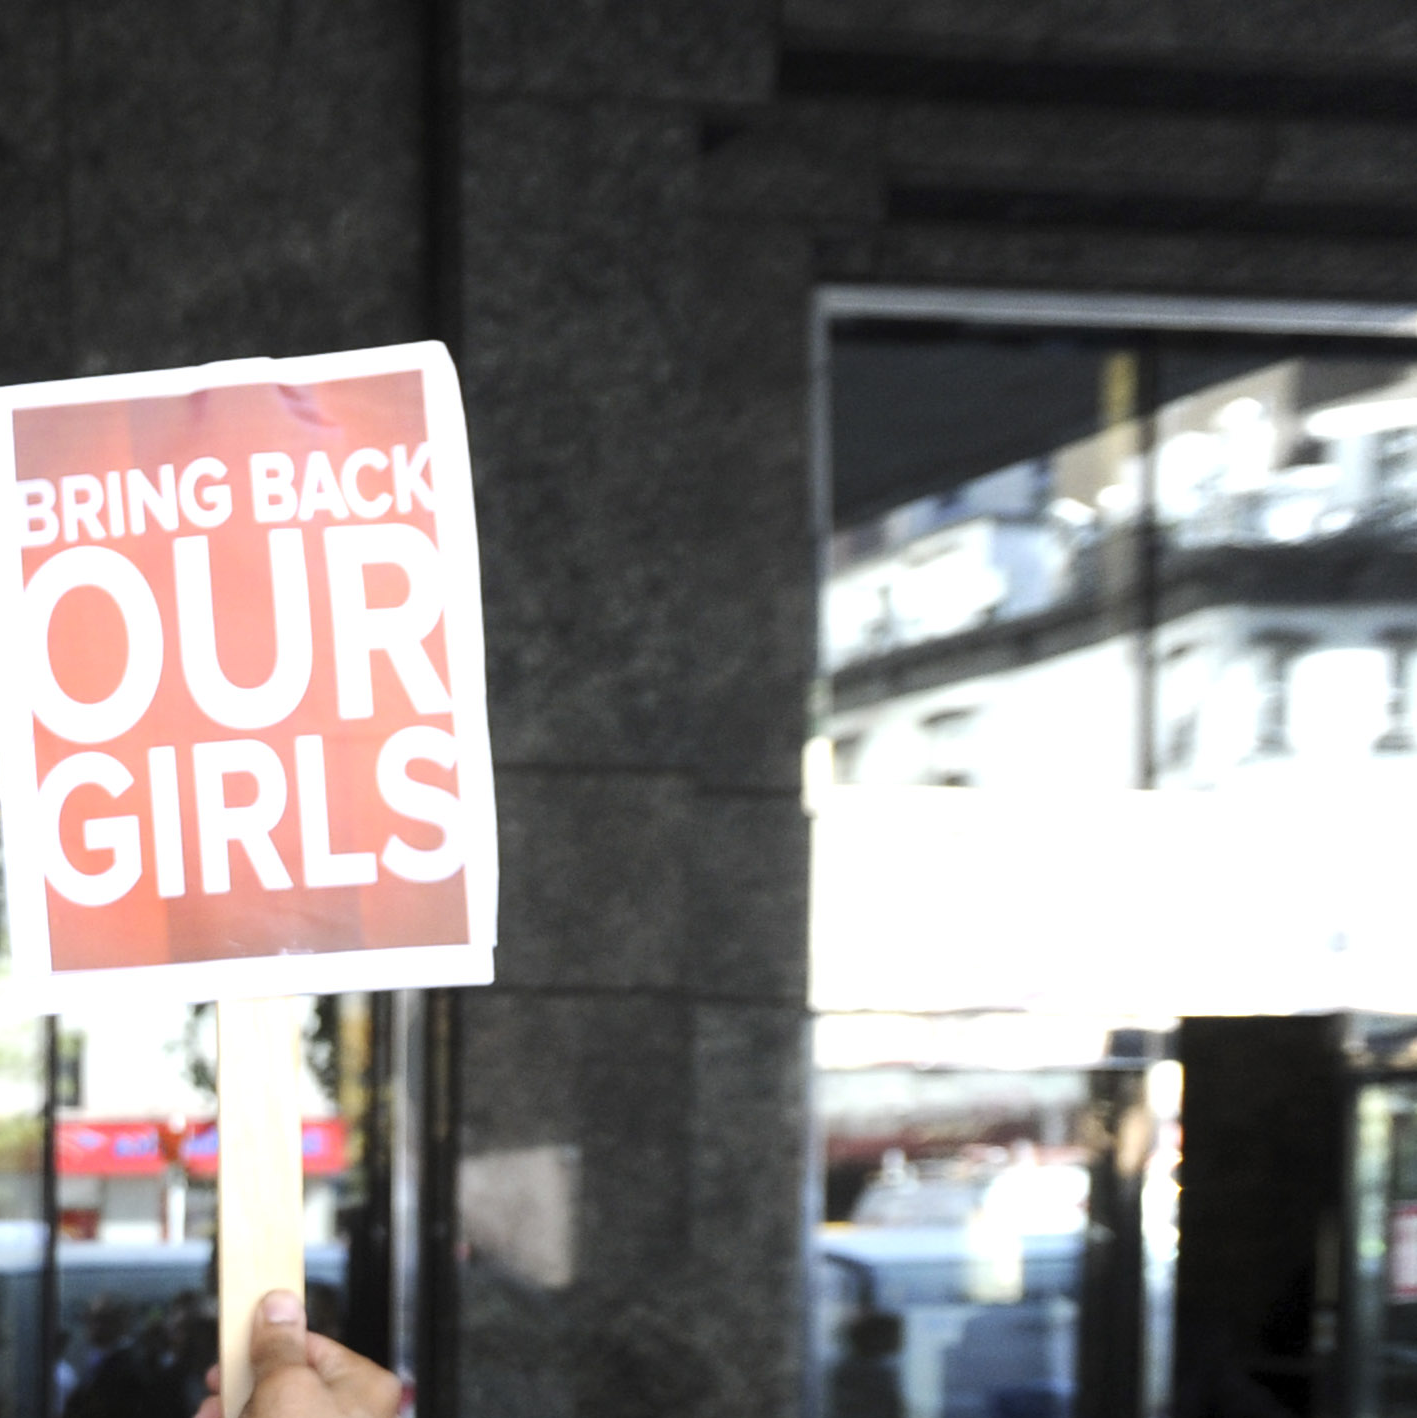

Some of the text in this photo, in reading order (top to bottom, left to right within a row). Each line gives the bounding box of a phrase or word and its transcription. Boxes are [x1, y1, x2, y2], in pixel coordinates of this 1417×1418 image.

[16, 439, 440, 548] BRING BACK
[23, 522, 454, 744] OUR
[38, 725, 467, 907] GIRLS
